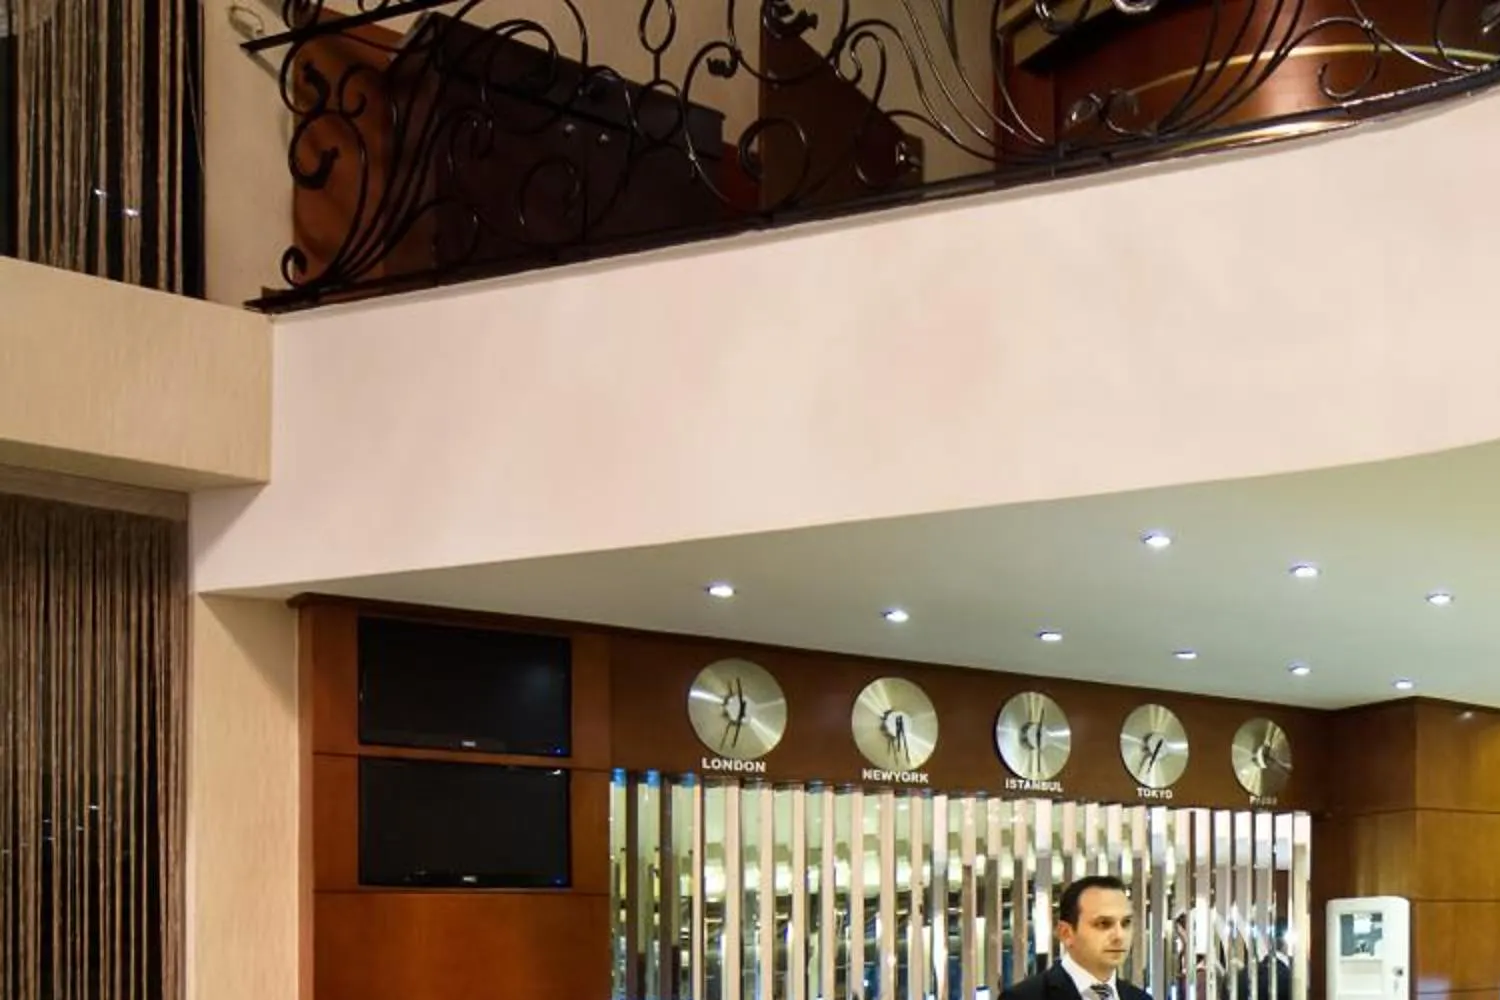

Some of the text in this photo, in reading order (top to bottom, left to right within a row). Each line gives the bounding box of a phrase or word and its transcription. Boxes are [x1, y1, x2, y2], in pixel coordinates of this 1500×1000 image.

[701, 757, 767, 773] LONDON
[862, 768, 929, 784] NEWYORK
[1136, 787, 1173, 799] TOKYO
